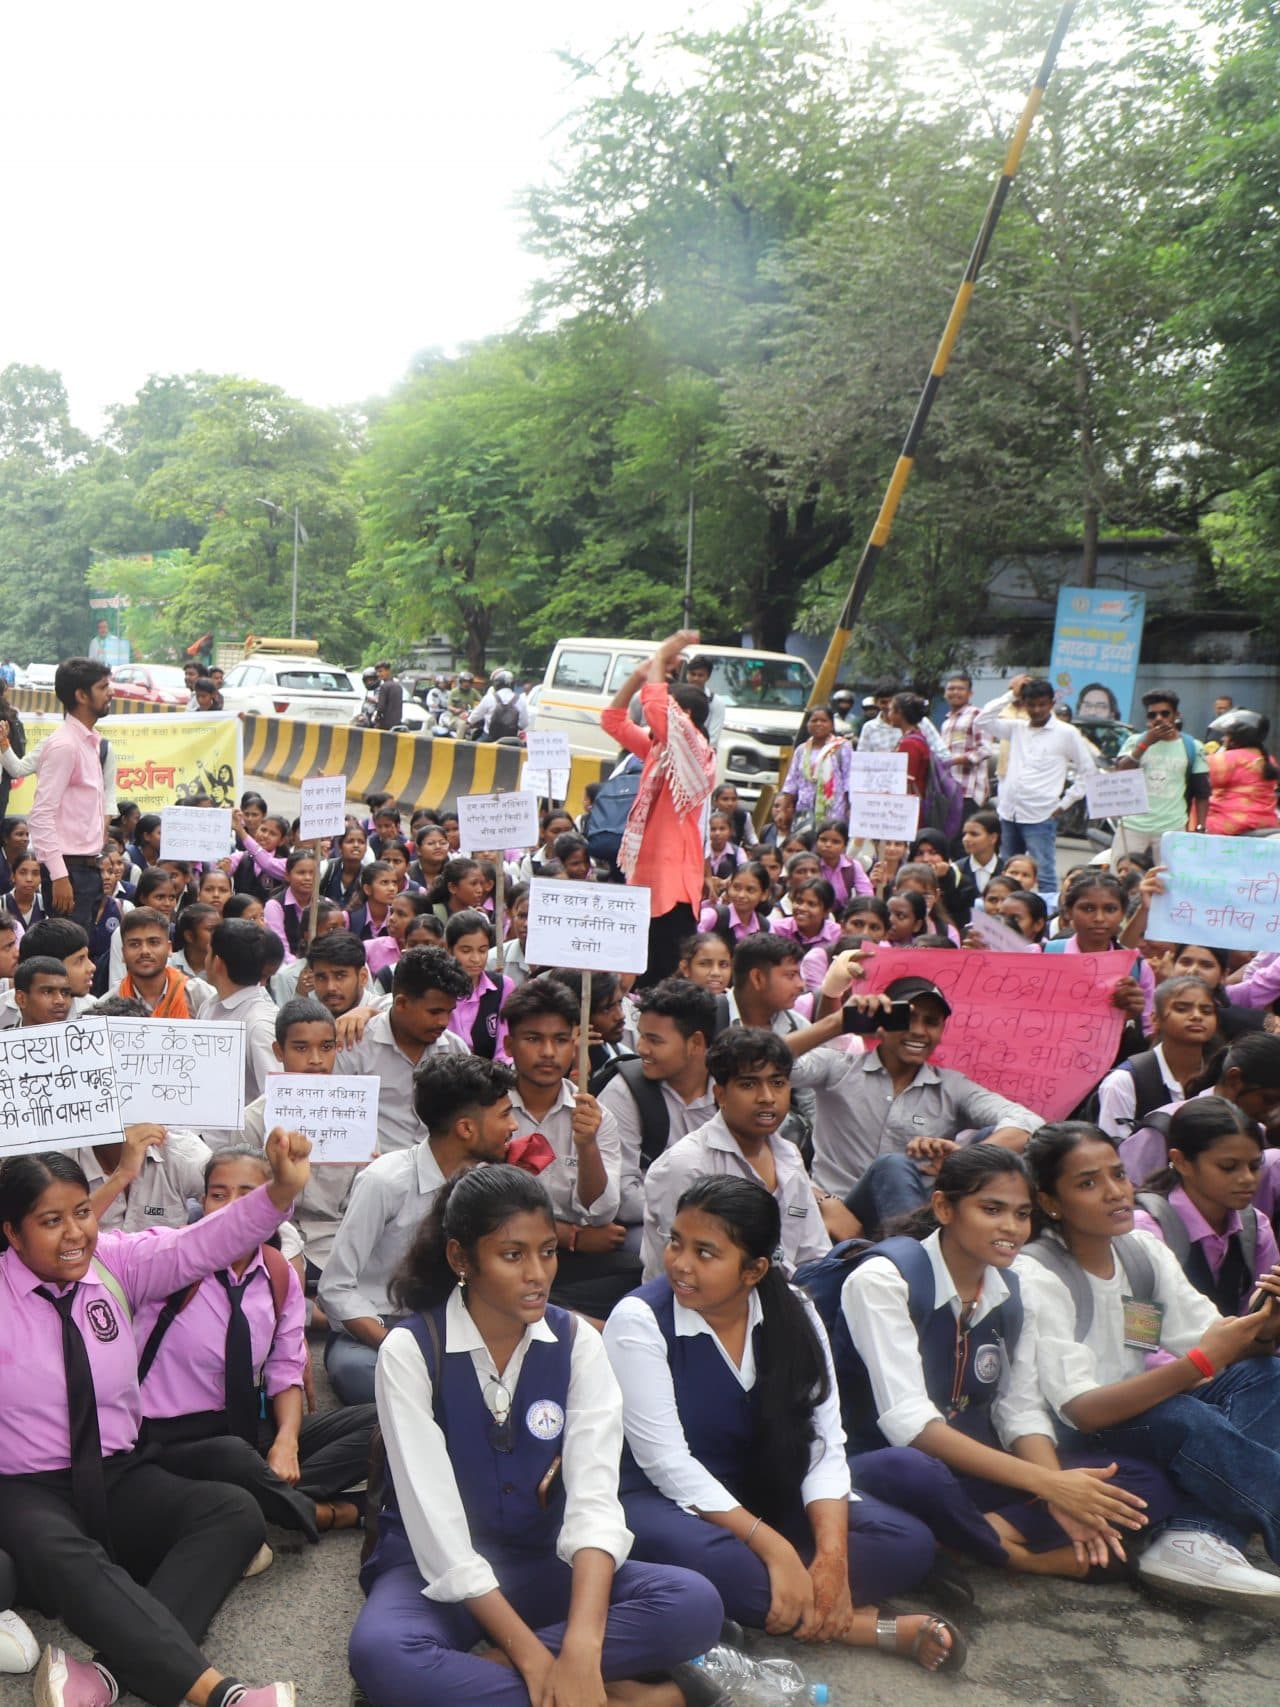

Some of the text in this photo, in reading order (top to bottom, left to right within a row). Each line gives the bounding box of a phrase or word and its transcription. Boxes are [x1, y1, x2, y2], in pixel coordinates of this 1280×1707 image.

[116, 760, 175, 792] दर्शन
[542, 892, 560, 904] हम
[564, 895, 588, 906] छात्र
[608, 898, 636, 912] हमारे
[538, 914, 638, 934] साथ राजनीति मत
[1205, 904, 1256, 933] भीख
[571, 936, 601, 953] खेलो!
[64, 1025, 108, 1058] किए
[110, 1025, 234, 1057] ढ़ाई के साथ
[19, 1072, 52, 1097] इंटर
[54, 1064, 79, 1089] की
[116, 1072, 200, 1107] द करो
[276, 1086, 367, 1101] हम अपना अधिकार
[21, 1094, 54, 1127] नीति
[56, 1100, 93, 1123] वापस
[95, 1088, 118, 1113] लो
[309, 1106, 329, 1120] नहीं
[332, 1106, 357, 1120] किसी
[358, 1105, 368, 1120] से
[295, 1125, 316, 1138] ीख
